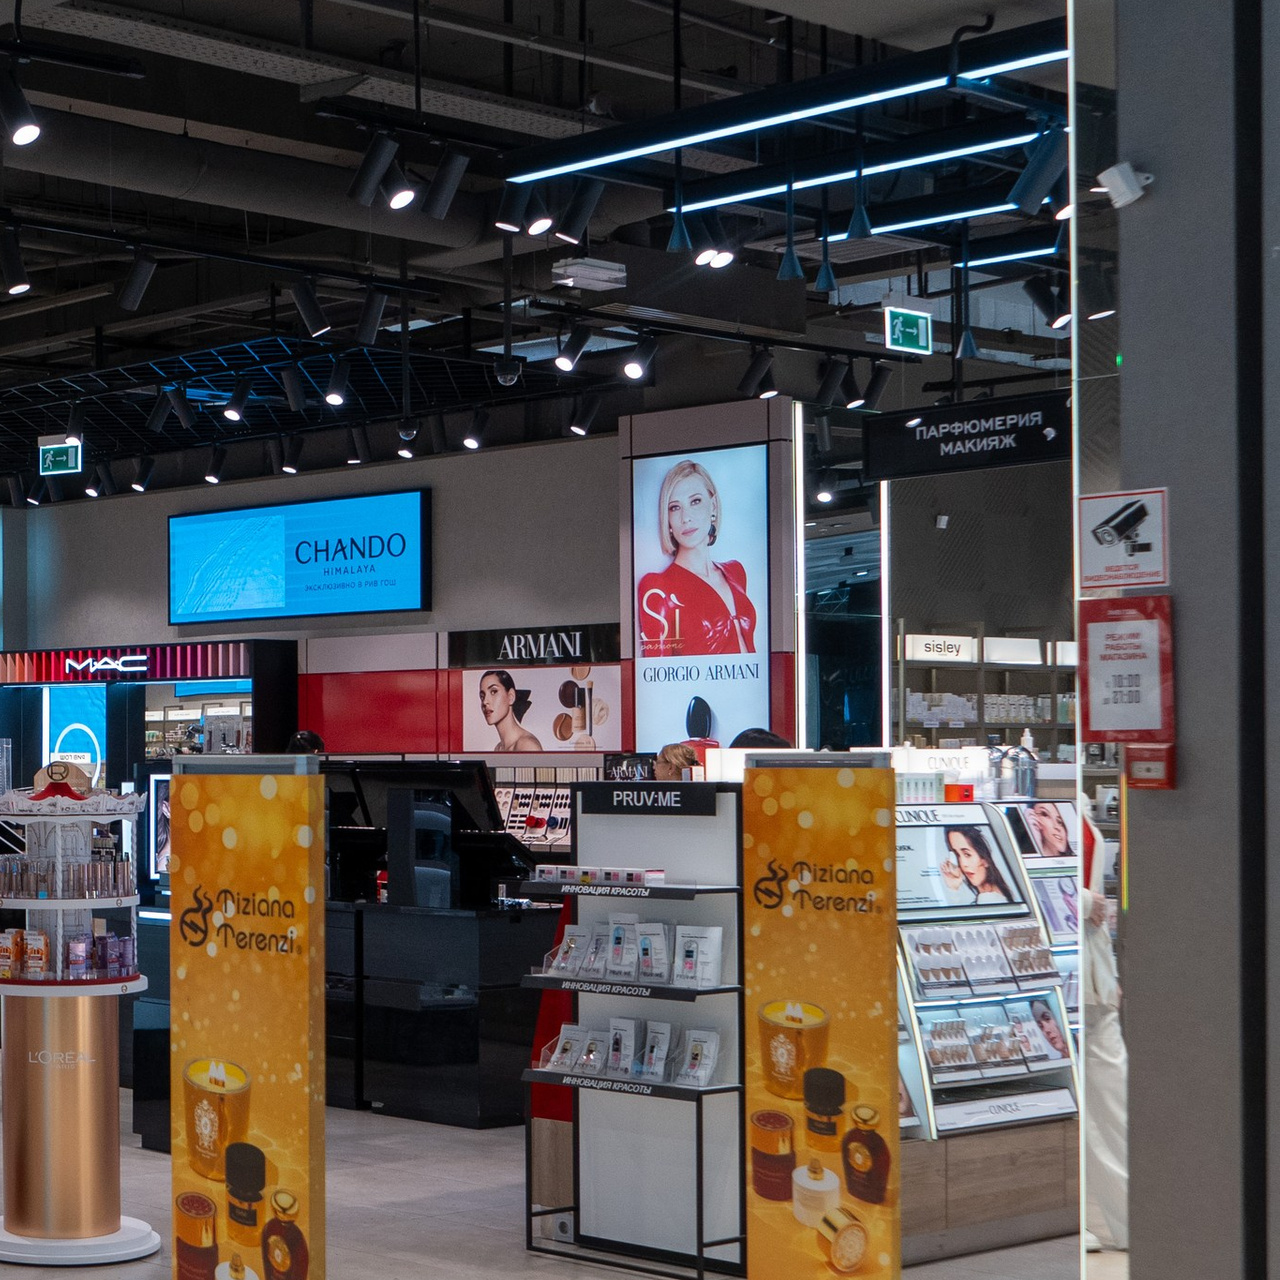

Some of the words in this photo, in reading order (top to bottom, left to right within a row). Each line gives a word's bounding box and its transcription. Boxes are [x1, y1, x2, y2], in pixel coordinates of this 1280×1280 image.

[915, 411, 1042, 440] ПАРФЮМЕРИЯ
[940, 434, 1016, 456] МАКИЯЖ
[295, 533, 406, 564] CHANDO
[323, 565, 376, 576] HIMALAYA
[305, 582, 356, 591] ЭКСКЛЮЗИВНО
[1105, 633, 1141, 641] РЕЖИМ
[497, 631, 582, 660] ARMANI
[924, 640, 961, 656] sisley
[1104, 643, 1142, 651] РАБОТЫ
[1099, 652, 1147, 662] МАГАЗИНА
[643, 666, 700, 682] GIORGIO
[705, 663, 759, 681] ARMANI
[928, 756, 969, 770] CLINIQUE
[611, 764, 648, 779] ARMANI
[613, 791, 681, 807] PRUV:ME
[895, 809, 941, 824] CLINIQUE
[792, 861, 874, 884] Tiziana
[561, 884, 610, 895] ИННОВАЦИЯ
[610, 887, 650, 897] КРАСОТЫ
[216, 889, 294, 918] Tiziana
[792, 889, 874, 912] Terenzi
[216, 923, 293, 953] Terenzi
[562, 981, 611, 993] ИННОВАЦИЯ
[610, 985, 651, 996] КРАСОТЫ
[563, 1076, 612, 1090] ИННОВАЦИЯ
[612, 1081, 652, 1094] КРАСОТЫ
